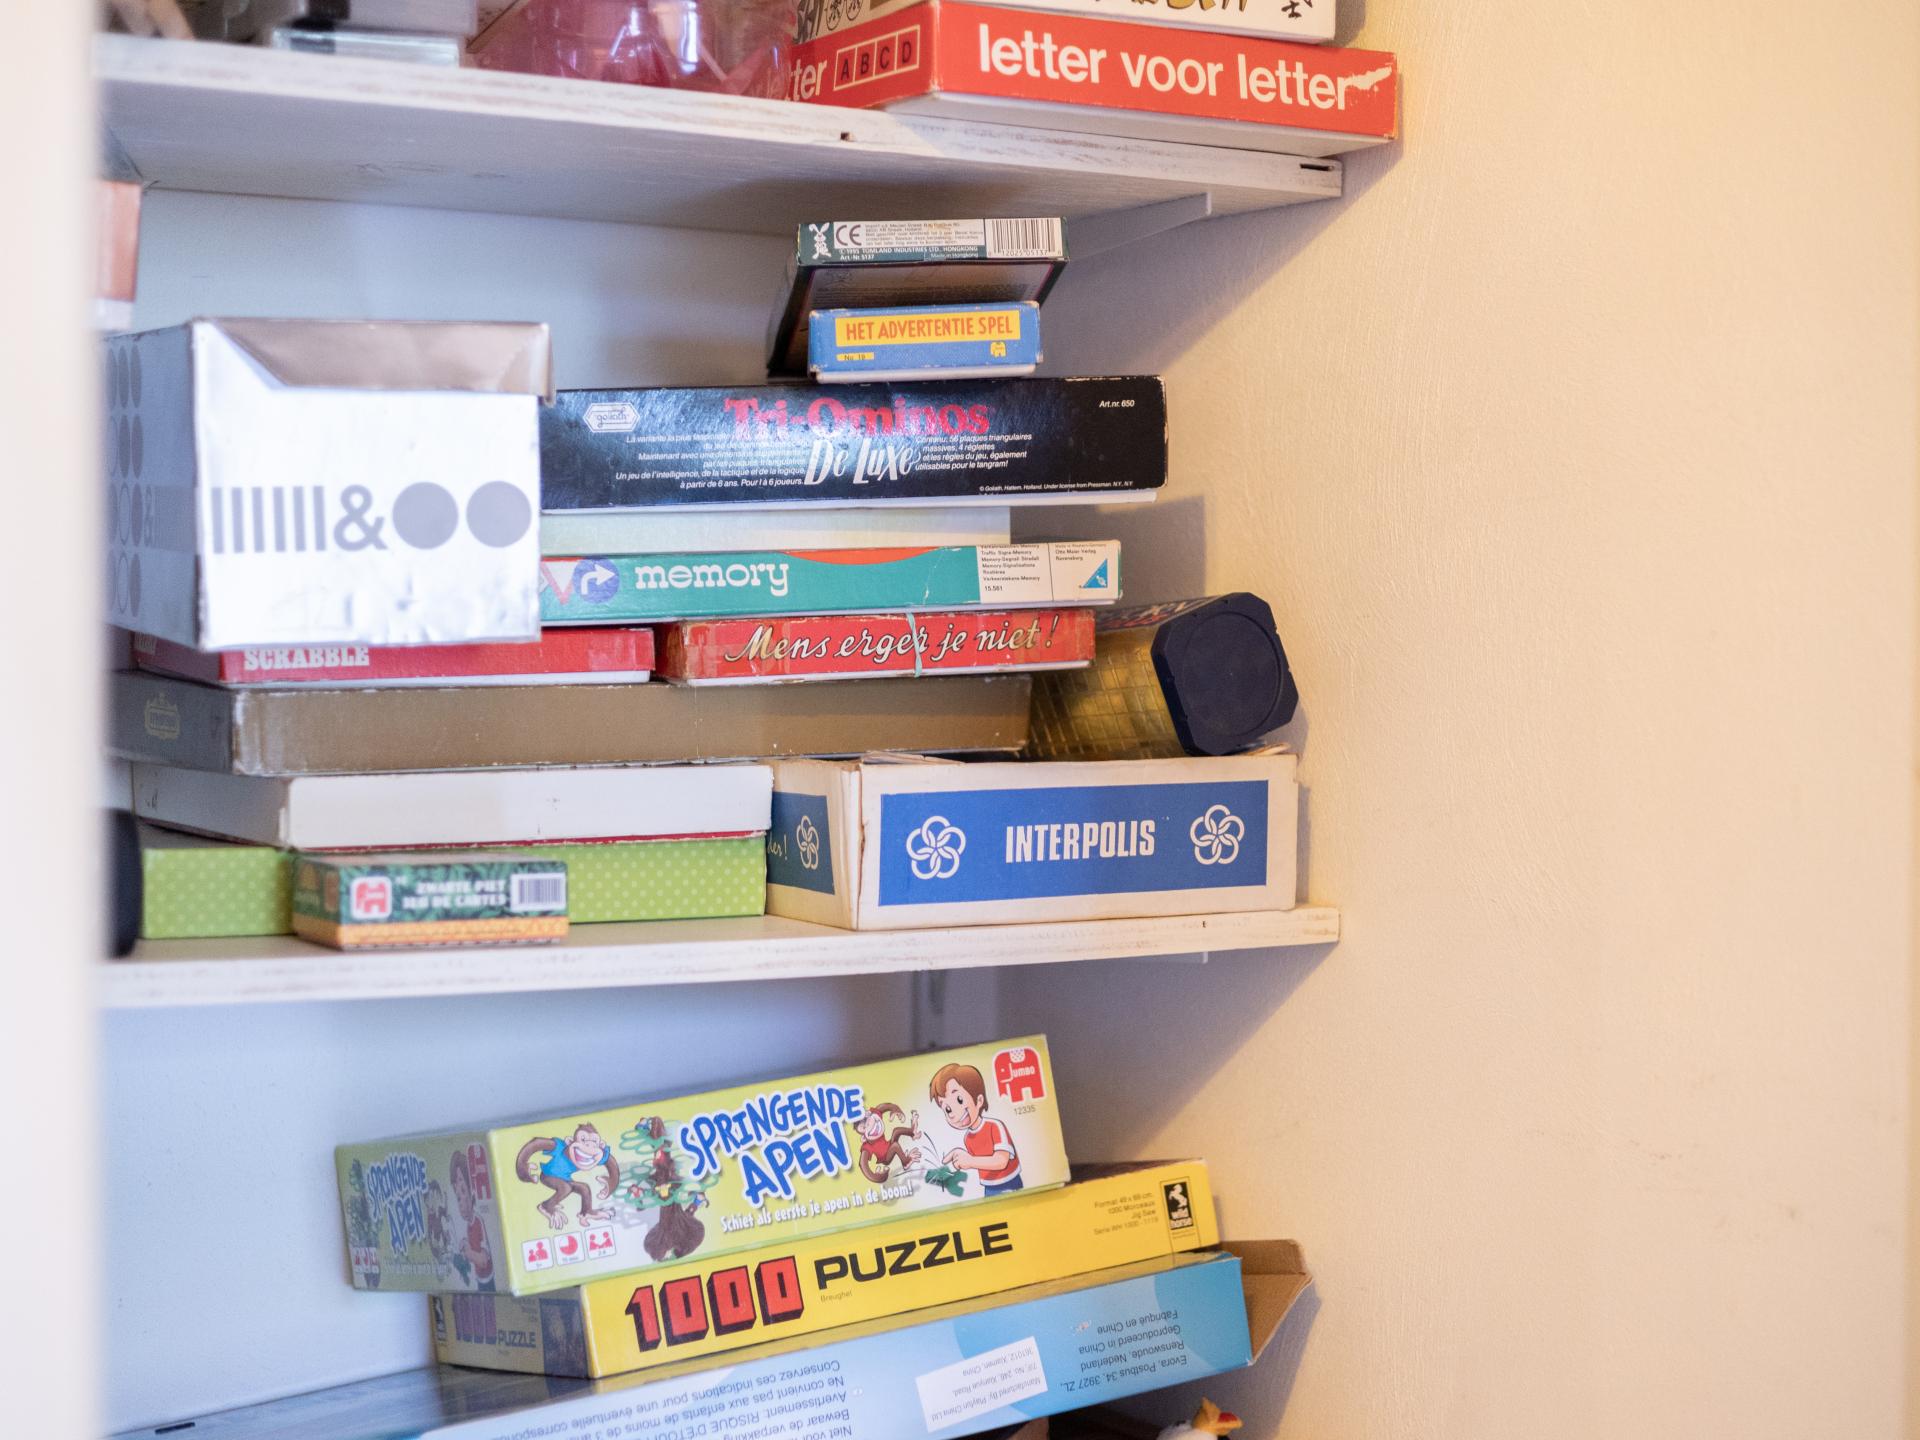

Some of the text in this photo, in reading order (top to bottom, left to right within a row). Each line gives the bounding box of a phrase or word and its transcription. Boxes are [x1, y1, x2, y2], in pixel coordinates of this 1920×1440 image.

[979, 23, 1349, 111] letter voor letter
[846, 316, 1013, 341] HET ADVERTENTIE SPEL
[1121, 399, 1135, 408] 650
[723, 397, 990, 439] Tri-Ominos
[959, 435, 987, 444] plaques
[989, 433, 1031, 443] triangulaires
[964, 443, 994, 451] réglettes
[638, 452, 679, 460] Maintenant
[803, 437, 921, 486] De Luxe
[942, 453, 964, 461] règles
[975, 452, 988, 460] jeu,
[989, 450, 1027, 460] également
[627, 472, 640, 480] jeu
[641, 471, 651, 479] de
[720, 468, 749, 477] tactique
[777, 466, 805, 476] logique,
[915, 462, 950, 470] utilisables
[951, 462, 968, 470] pour
[976, 460, 1008, 470] tangram!
[686, 481, 705, 489] partir
[740, 478, 757, 486] Pour
[773, 477, 804, 487] joueurs.
[634, 563, 789, 597] memory
[724, 625, 829, 662] Mens
[833, 626, 928, 664] erger
[930, 622, 964, 662] je
[976, 616, 1041, 652] niet
[244, 646, 370, 671] SCRABBLE
[1006, 819, 1156, 864] INTERPOLIS
[680, 1086, 864, 1176] SPRINGENDE
[740, 1120, 850, 1205] APEN
[366, 1155, 428, 1220] SPRINGENDE
[719, 1179, 914, 1231] Schiet als eerste je apen in de boom!
[387, 1194, 426, 1254] APEN
[625, 1222, 1013, 1353] 1000 PUZZLE
[1096, 1321, 1124, 1336] Chine
[1125, 1318, 1137, 1327] en
[499, 1330, 536, 1348] PUZZLE
[1077, 1323, 1181, 1356] Geproduceerd in China
[1079, 1352, 1127, 1372] Nederland
[1118, 1361, 1157, 1379] Postbus
[1157, 1354, 1188, 1369] Evora,
[961, 1364, 982, 1378] China
[776, 1379, 825, 1400] convient
[826, 1374, 844, 1388] Ne
[1077, 1375, 1101, 1389] 3927
[569, 1358, 841, 1431] Conservez ces indications pour une éventuelle
[727, 1396, 750, 1410] aux
[751, 1389, 774, 1404] pas
[663, 1412, 679, 1425] de
[680, 1401, 726, 1421] enfants
[805, 1407, 850, 1428] Bewaar
[941, 1404, 962, 1417] China
[624, 1417, 661, 1434] moins
[709, 1410, 760, 1433] RISQUE
[788, 1419, 804, 1433] de
[605, 1425, 622, 1439] de
[827, 1424, 852, 1439] Niet
